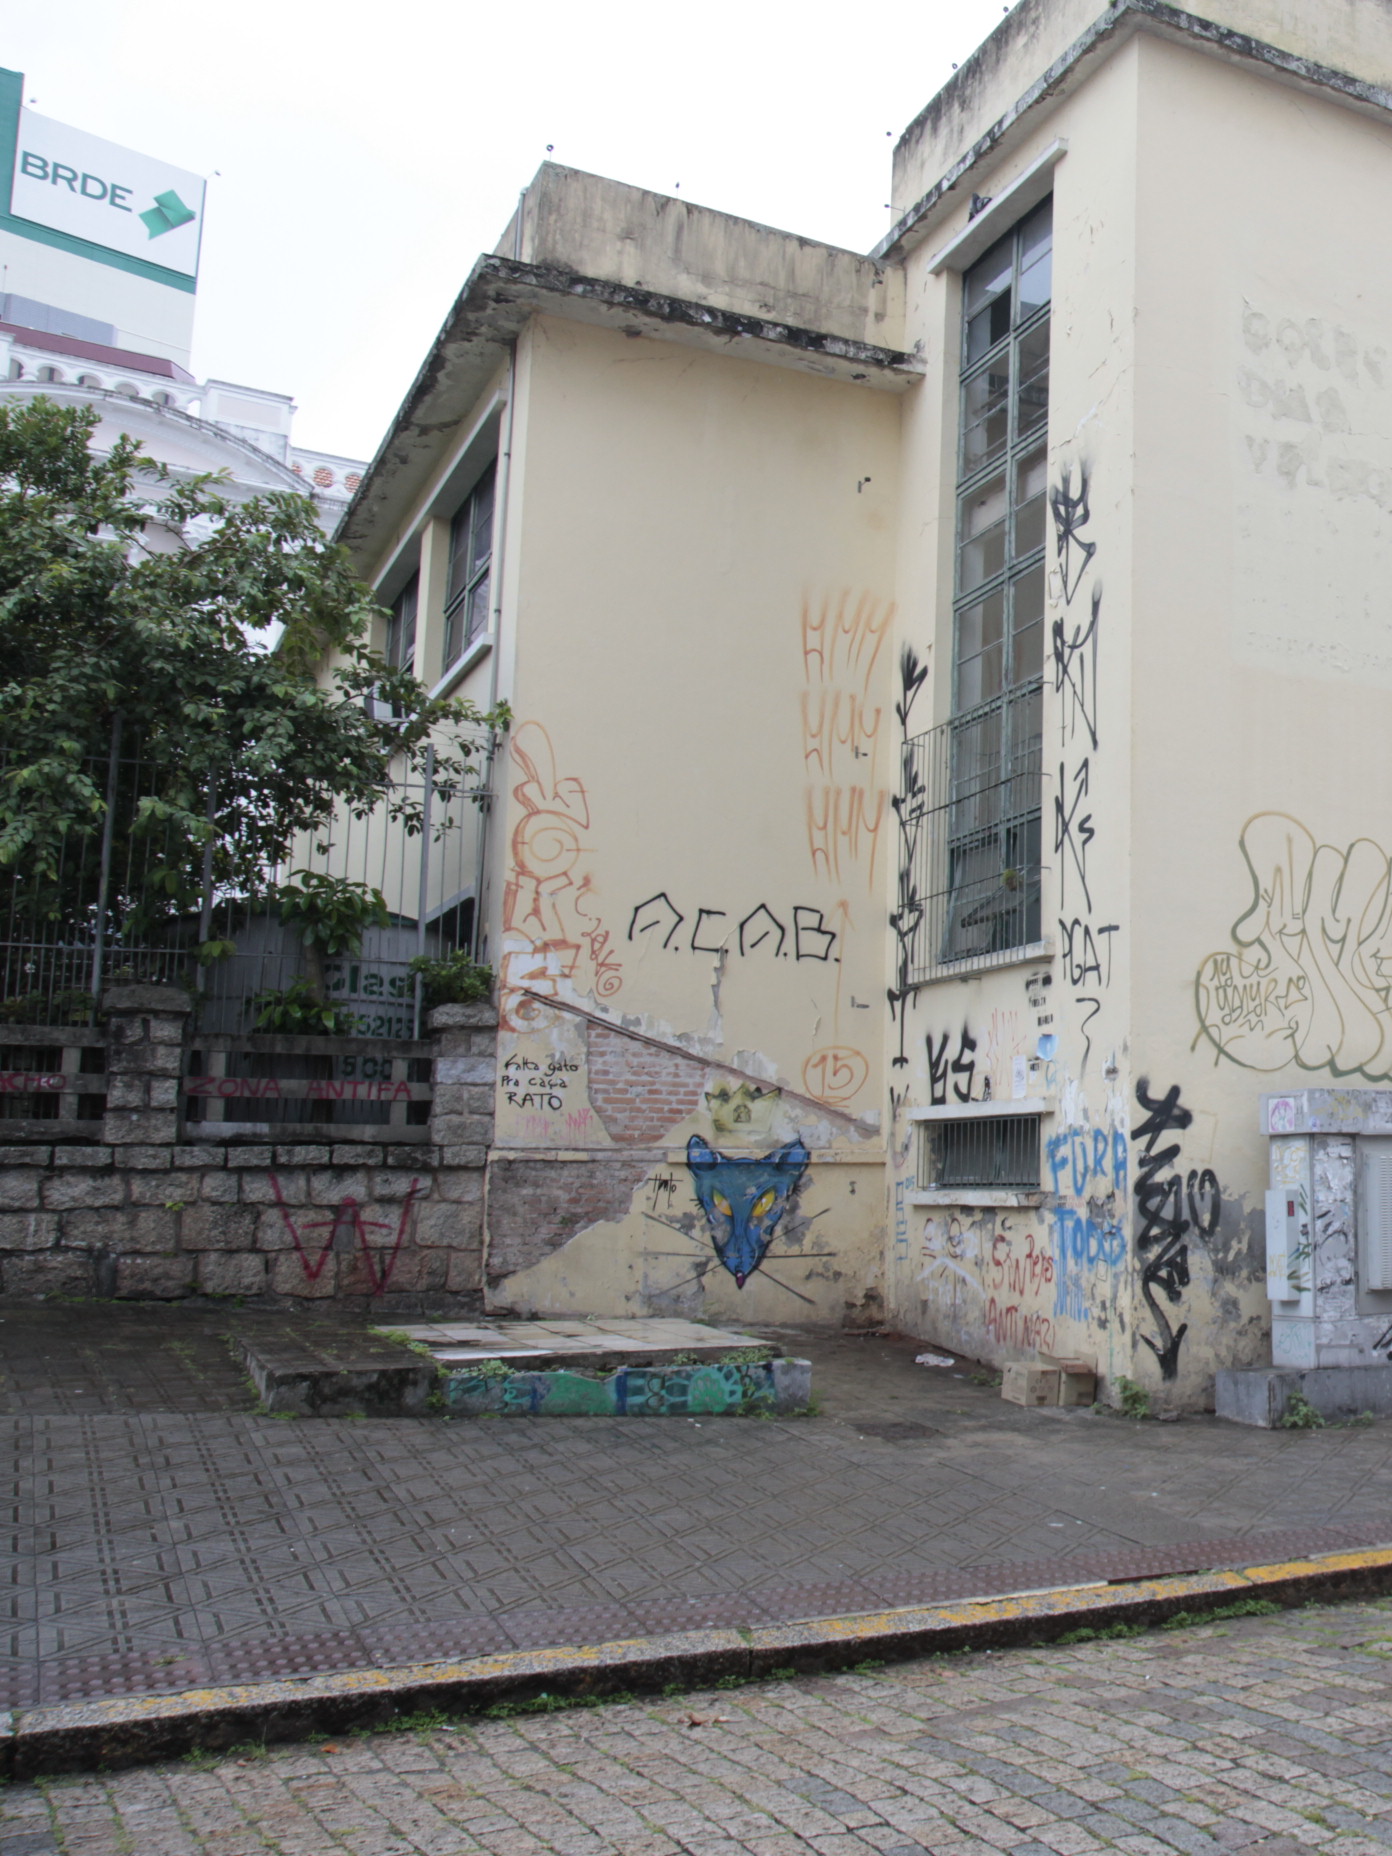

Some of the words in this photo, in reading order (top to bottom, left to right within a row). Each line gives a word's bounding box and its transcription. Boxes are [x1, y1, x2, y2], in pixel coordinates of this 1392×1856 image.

[20, 150, 134, 213] BRDE
[544, 1058, 580, 1077] gato
[188, 1076, 282, 1097] ZONA
[306, 1080, 413, 1100] ANTIFA
[505, 1091, 563, 1111] RATO
